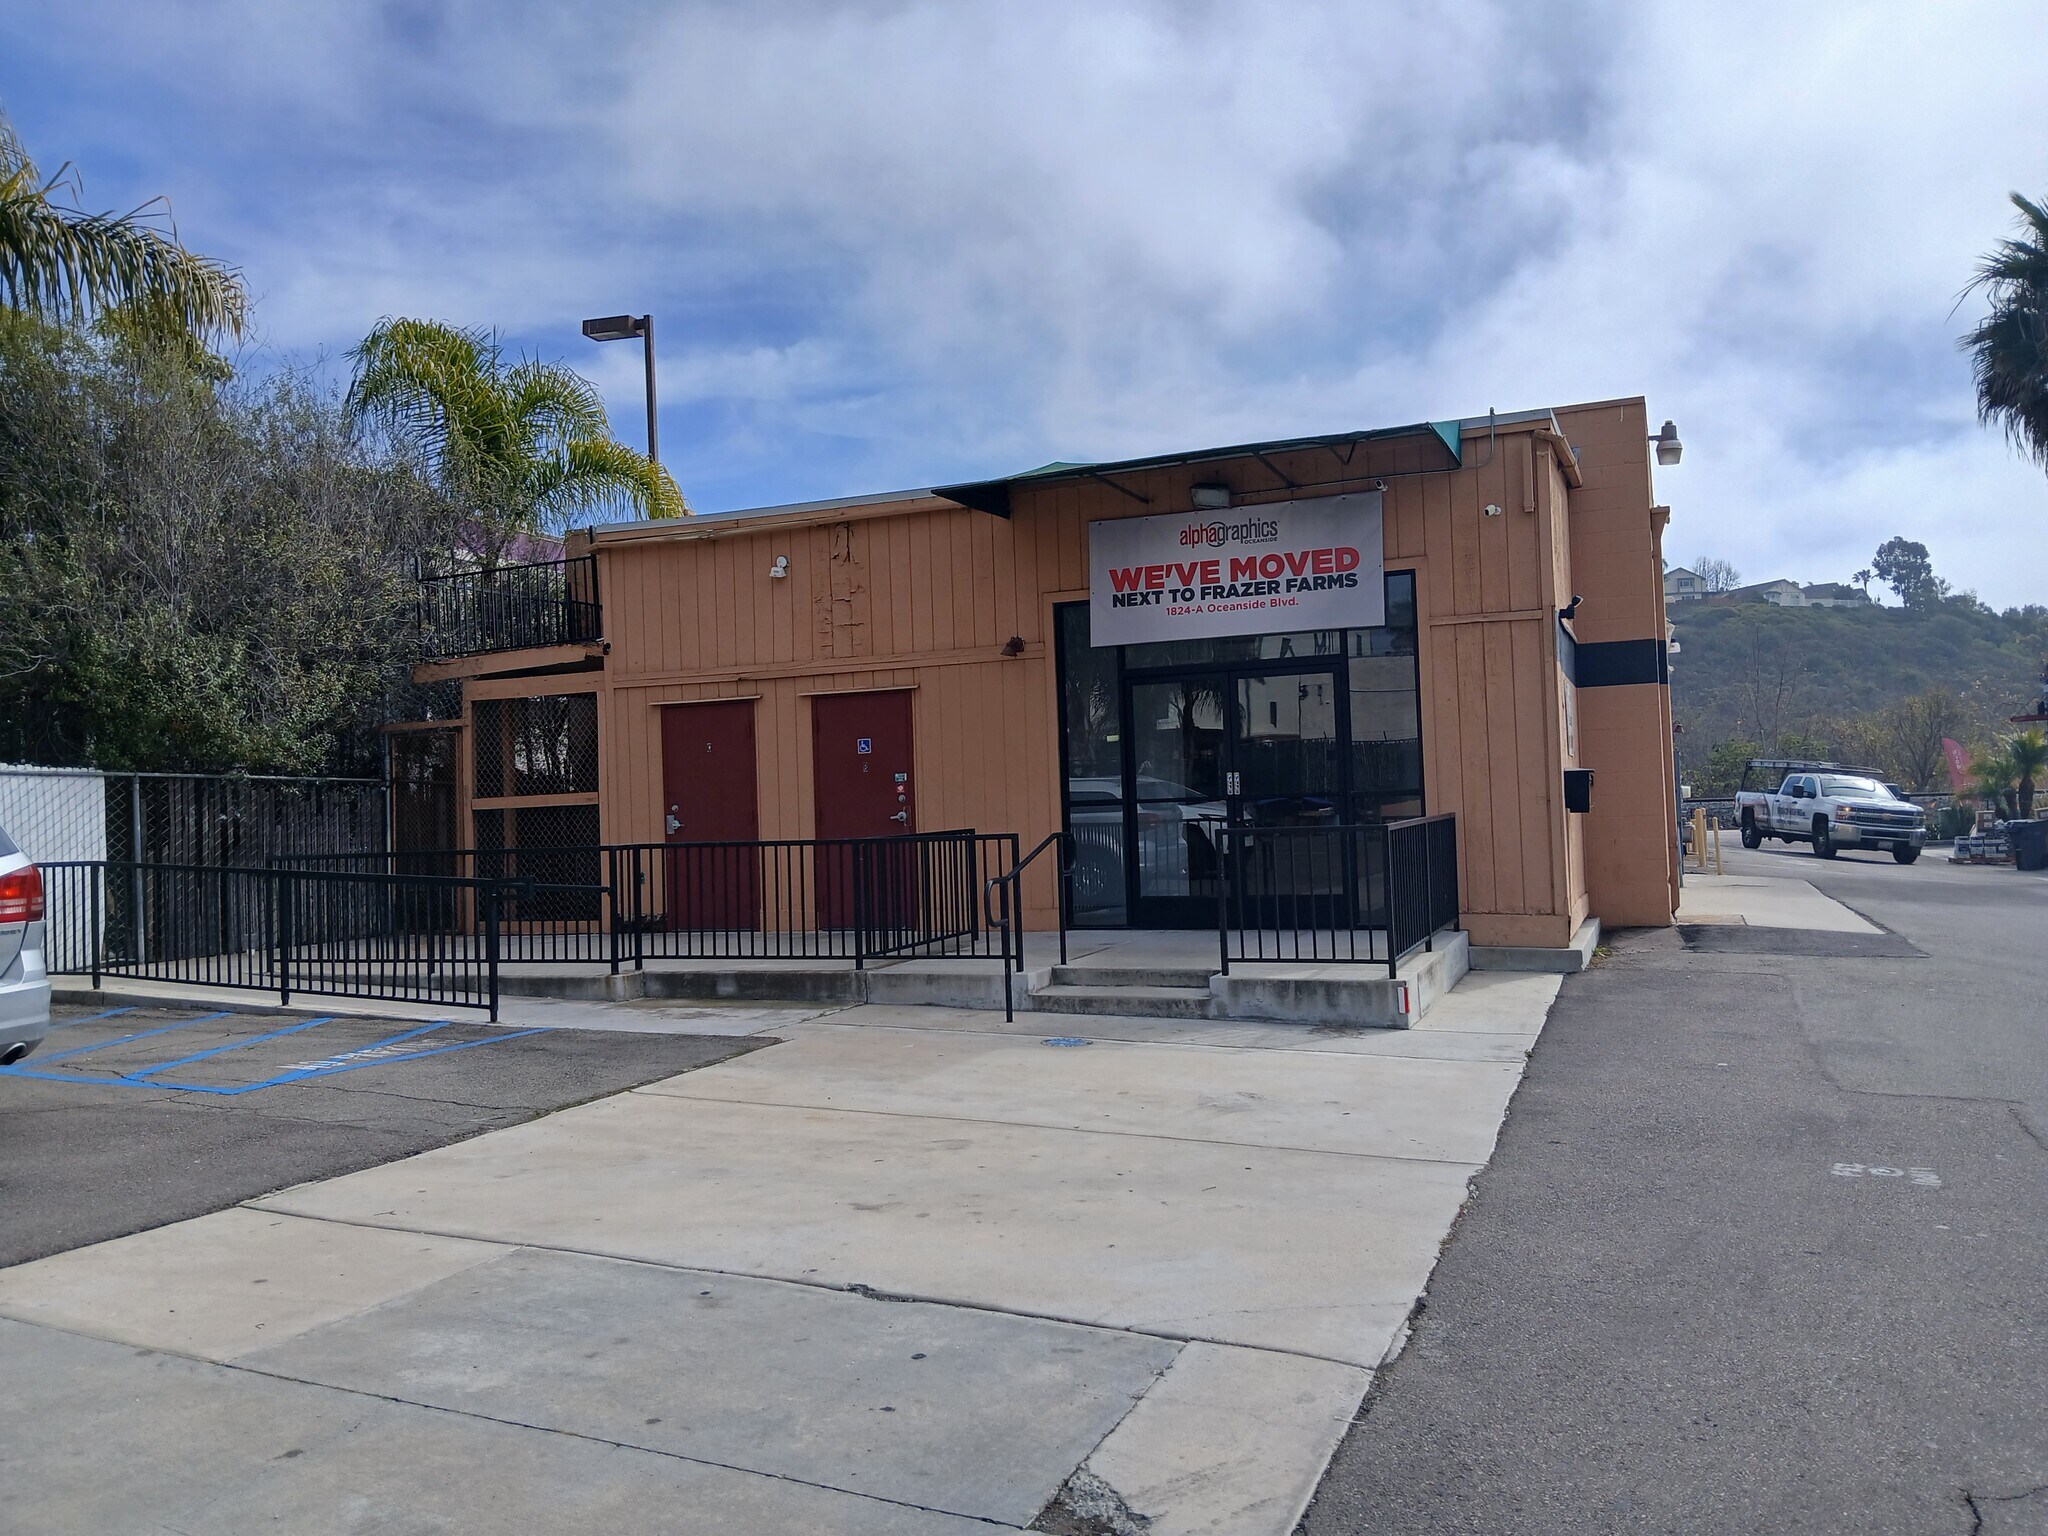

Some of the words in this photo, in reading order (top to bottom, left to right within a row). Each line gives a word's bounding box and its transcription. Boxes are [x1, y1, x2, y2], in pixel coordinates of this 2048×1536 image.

[1180, 517, 1278, 548] alphagraphics
[1244, 537, 1278, 545] OCEANSIDE
[1108, 559, 1221, 592] WE'VE
[1229, 546, 1360, 582] MOVED
[1112, 590, 1164, 608] NEXT
[1168, 587, 1195, 603] TO
[1200, 580, 1280, 600] FRAZER
[1285, 572, 1358, 593] FARMS
[1166, 605, 1204, 616] 1824-A
[1207, 600, 1266, 613] Oceanside
[1270, 597, 1299, 608] Blvd.
